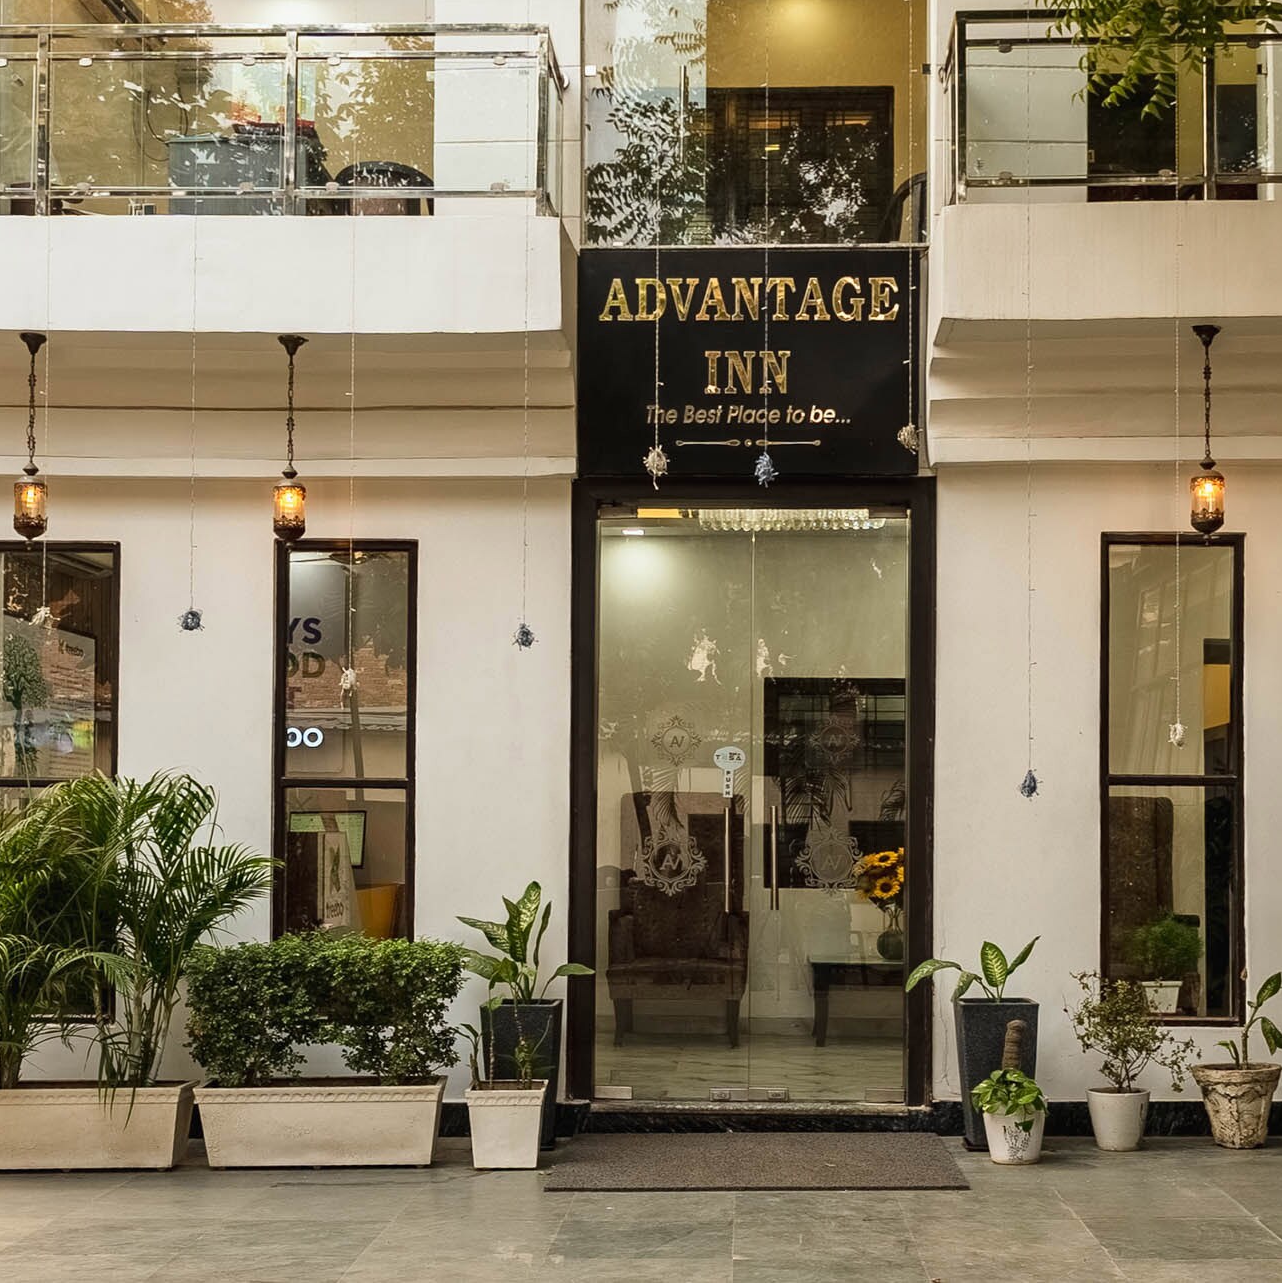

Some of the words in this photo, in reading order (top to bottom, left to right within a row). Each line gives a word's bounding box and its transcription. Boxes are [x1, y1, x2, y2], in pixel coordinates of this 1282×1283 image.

[598, 276, 900, 322] ADVANTAGE
[704, 350, 791, 395] INN
[646, 404, 678, 424] The
[683, 404, 723, 424] Best
[726, 404, 781, 424] Place
[786, 404, 806, 424] to
[809, 404, 852, 424] be...
